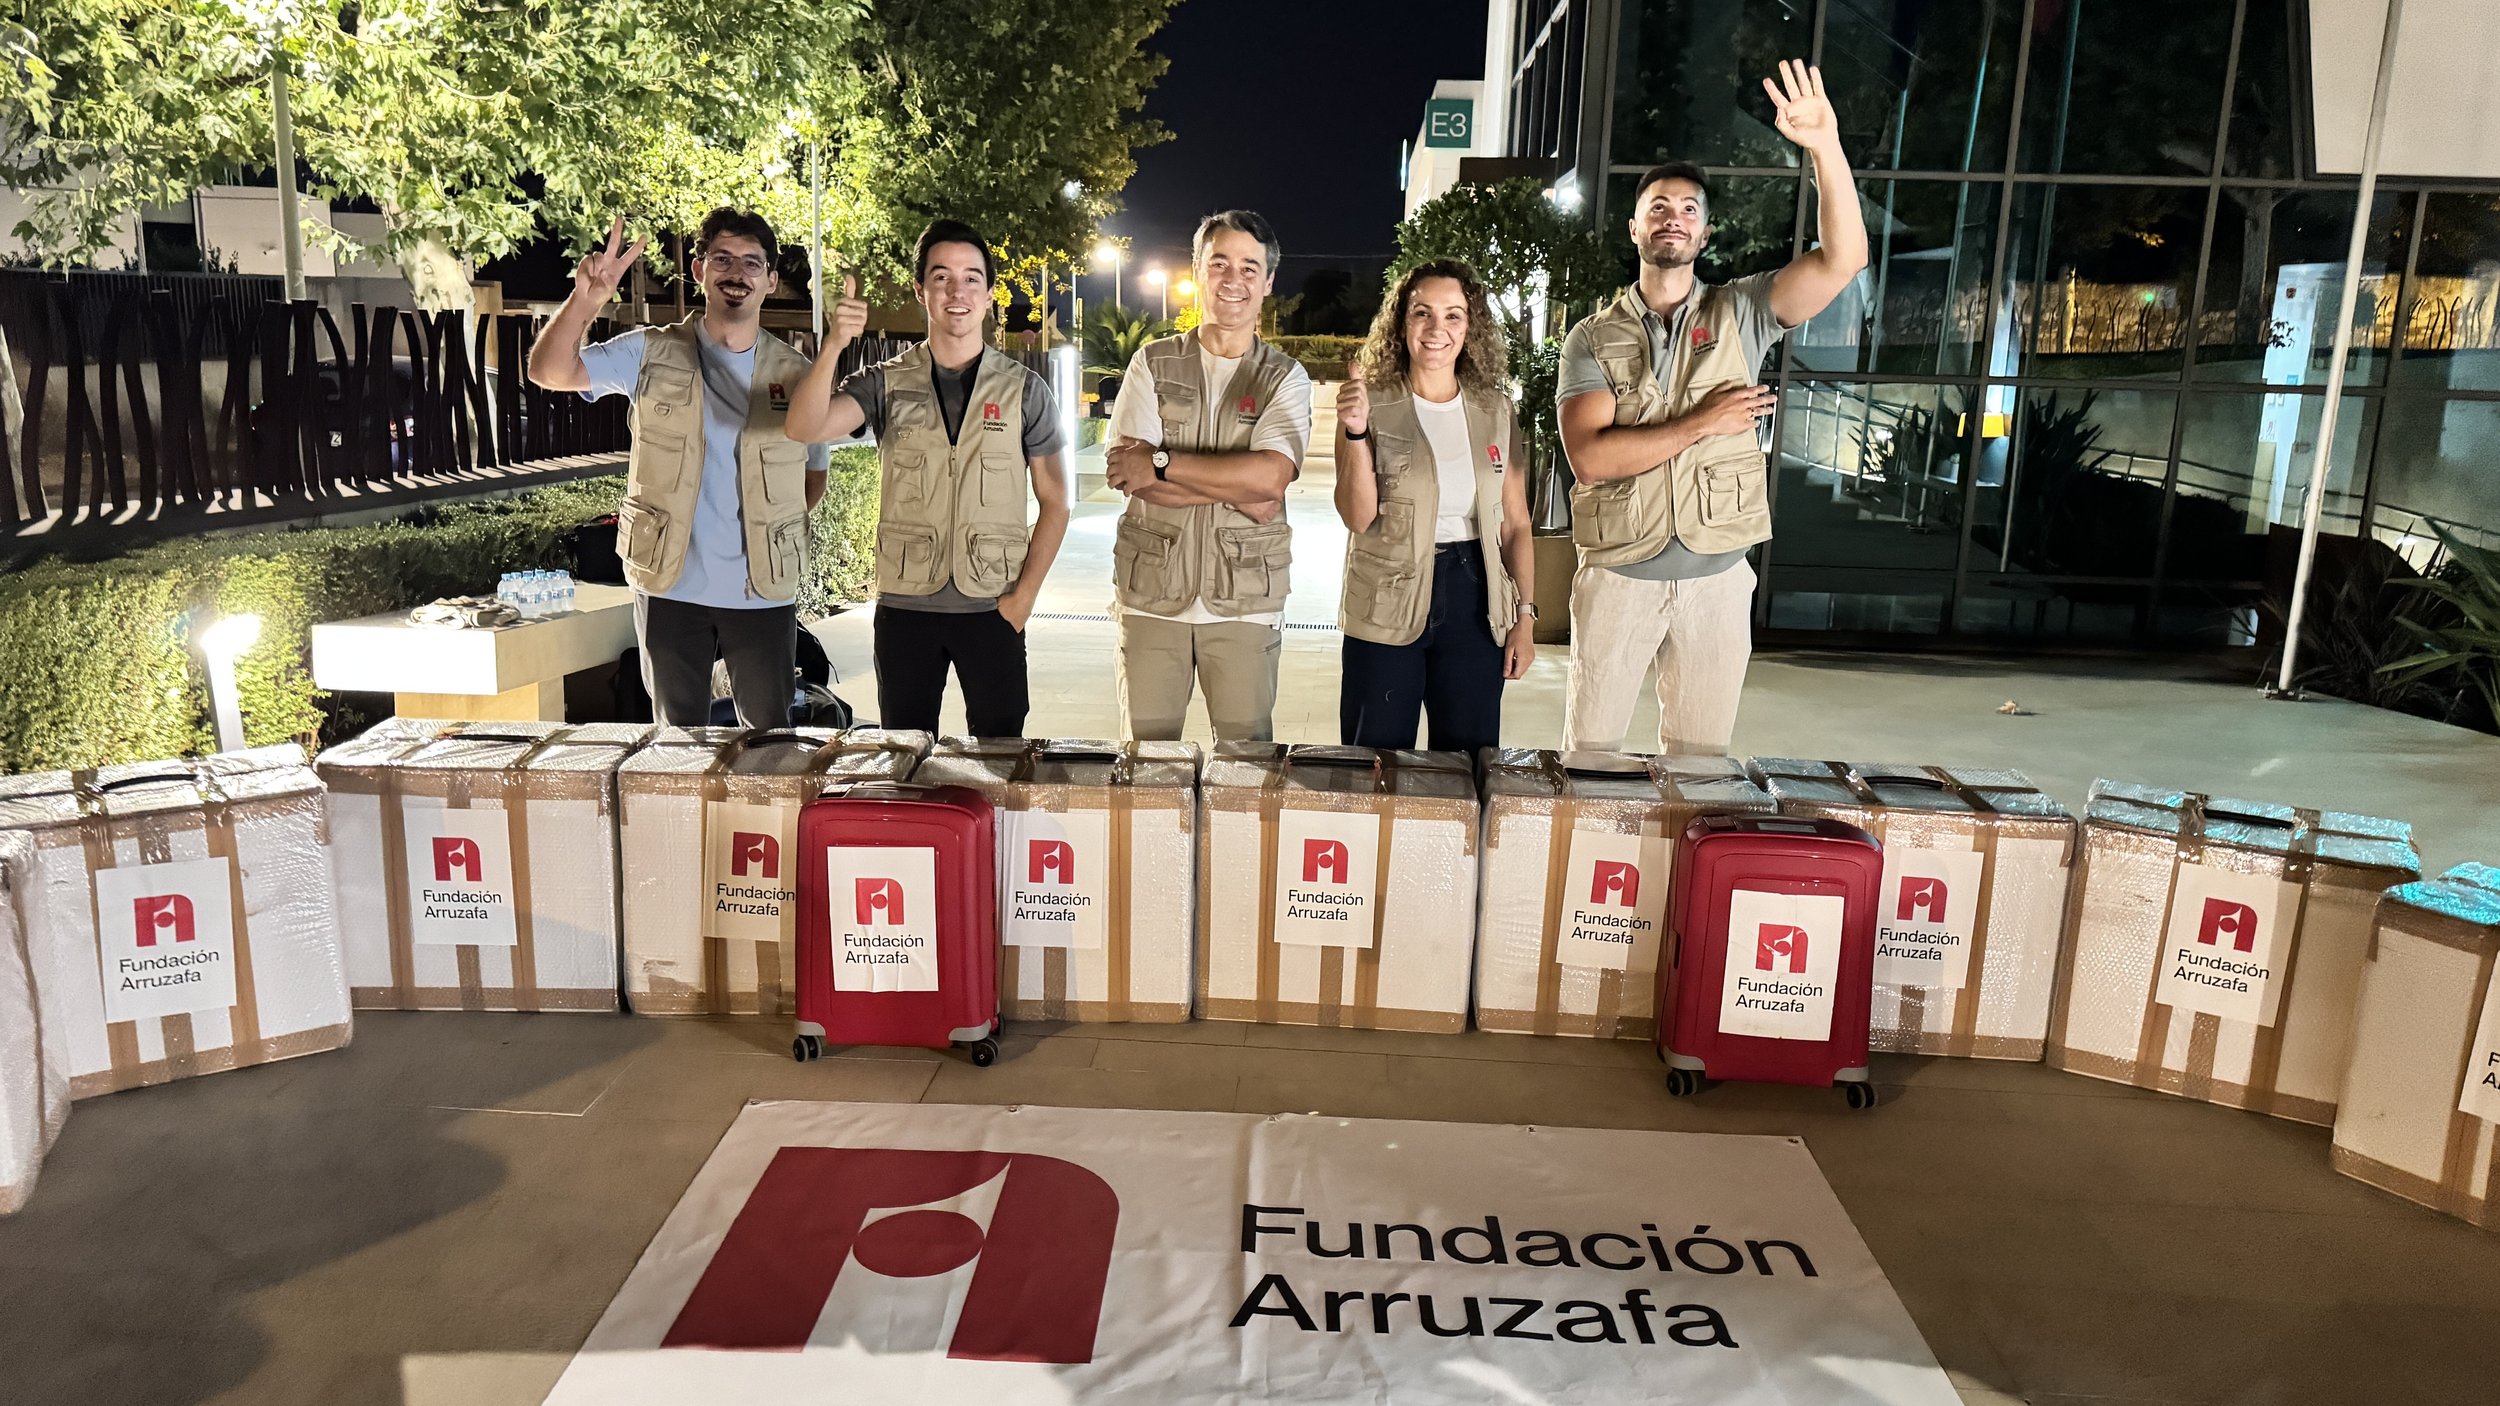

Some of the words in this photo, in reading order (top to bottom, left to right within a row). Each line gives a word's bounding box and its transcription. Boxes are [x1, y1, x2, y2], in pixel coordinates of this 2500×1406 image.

[1431, 112, 1466, 137] E3
[423, 889, 502, 903] Fundación
[717, 883, 795, 901] Fundación
[1015, 891, 1091, 906] Fundación
[1288, 889, 1363, 906] Fundación
[424, 905, 488, 919] Arruzafa
[716, 899, 779, 916] Arruzafa
[1014, 907, 1076, 921] Arruzafa
[1287, 905, 1348, 921] Arruzafa
[1574, 910, 1652, 931] Fundación
[844, 934, 924, 947] Fundación
[1571, 926, 1634, 944] Arruzafa
[1880, 927, 1960, 946] Fundación
[119, 949, 219, 973] Fundación
[845, 951, 909, 965] Arruzafa
[1876, 943, 1942, 961] Arruzafa
[2177, 948, 2270, 980] Fundación
[120, 969, 201, 991] Arruzafa
[1738, 976, 1823, 997] Fundación
[2173, 966, 2248, 993] Arruzafa
[1735, 994, 1805, 1013] Arruzafa
[1240, 1203, 1819, 1278] Fundación
[1228, 1273, 1739, 1349] Arruzafa
